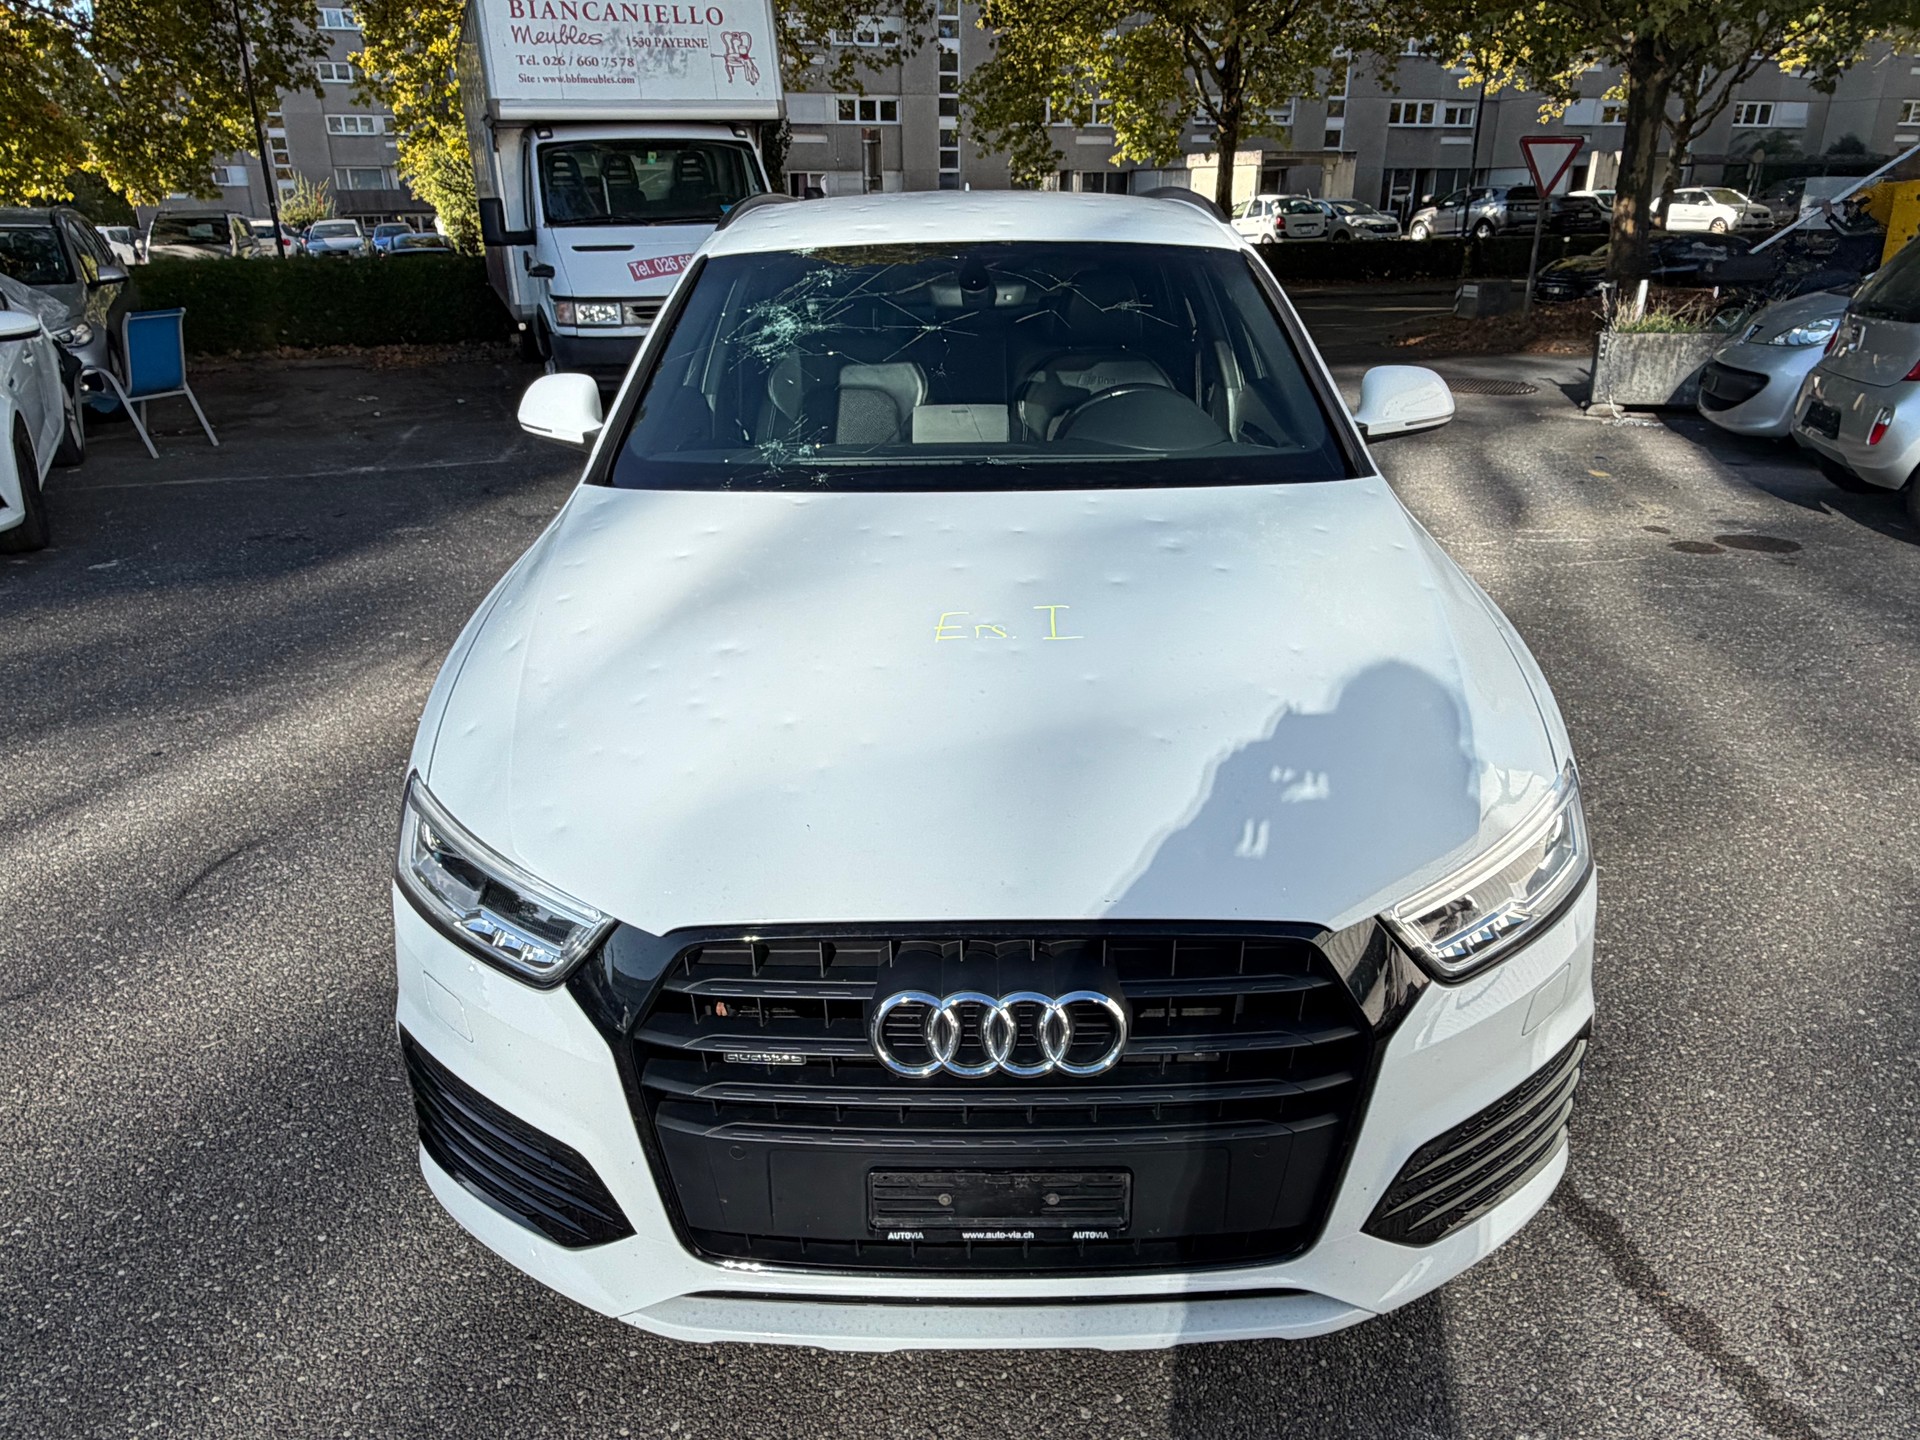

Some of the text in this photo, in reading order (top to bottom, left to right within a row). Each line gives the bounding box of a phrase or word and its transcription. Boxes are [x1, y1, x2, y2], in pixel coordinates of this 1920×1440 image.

[509, 0, 724, 25] BIANCANIELLO
[510, 23, 603, 46] Meubles
[625, 34, 709, 49] 1530 PAYERNE
[516, 54, 540, 66] Tél.
[542, 56, 566, 67] 026
[577, 56, 599, 67] 660
[542, 73, 636, 84] www.bbfmeubles.com
[630, 260, 655, 277] Tel.
[654, 257, 679, 273] 026
[887, 1231, 925, 1240] AUTOVIA
[961, 1230, 1035, 1240] www.auto-via.ch
[1072, 1231, 1110, 1240] AUTOVIA
